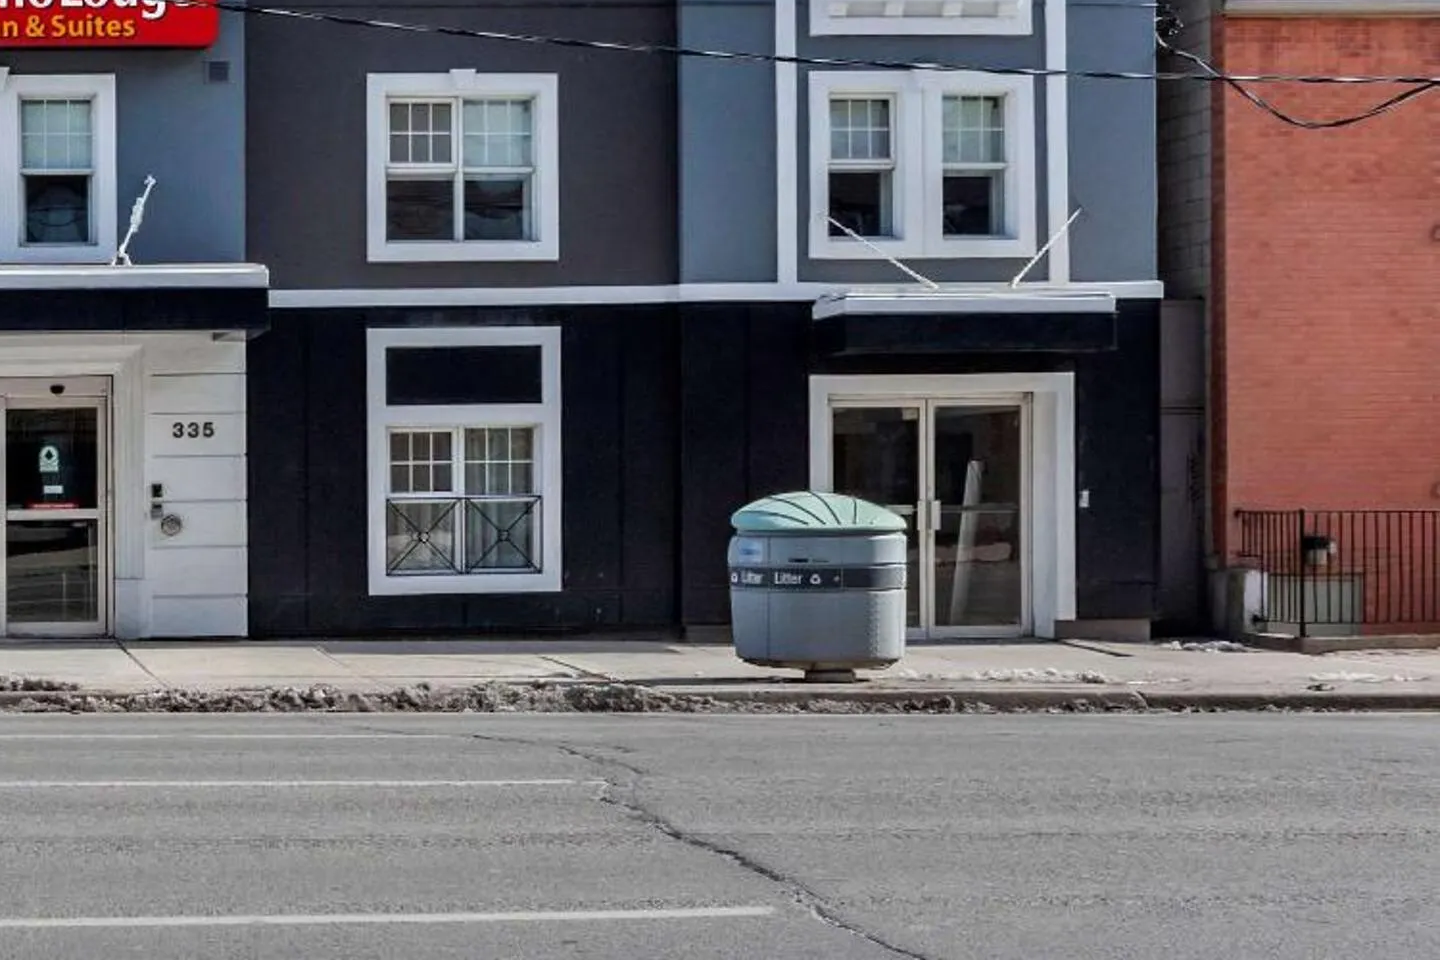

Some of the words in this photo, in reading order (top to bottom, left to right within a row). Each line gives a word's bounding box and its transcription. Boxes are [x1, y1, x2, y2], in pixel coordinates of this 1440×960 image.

[26, 15, 46, 38] &
[51, 14, 136, 38] Suites
[172, 421, 215, 439] 335
[774, 571, 802, 585] Litter
